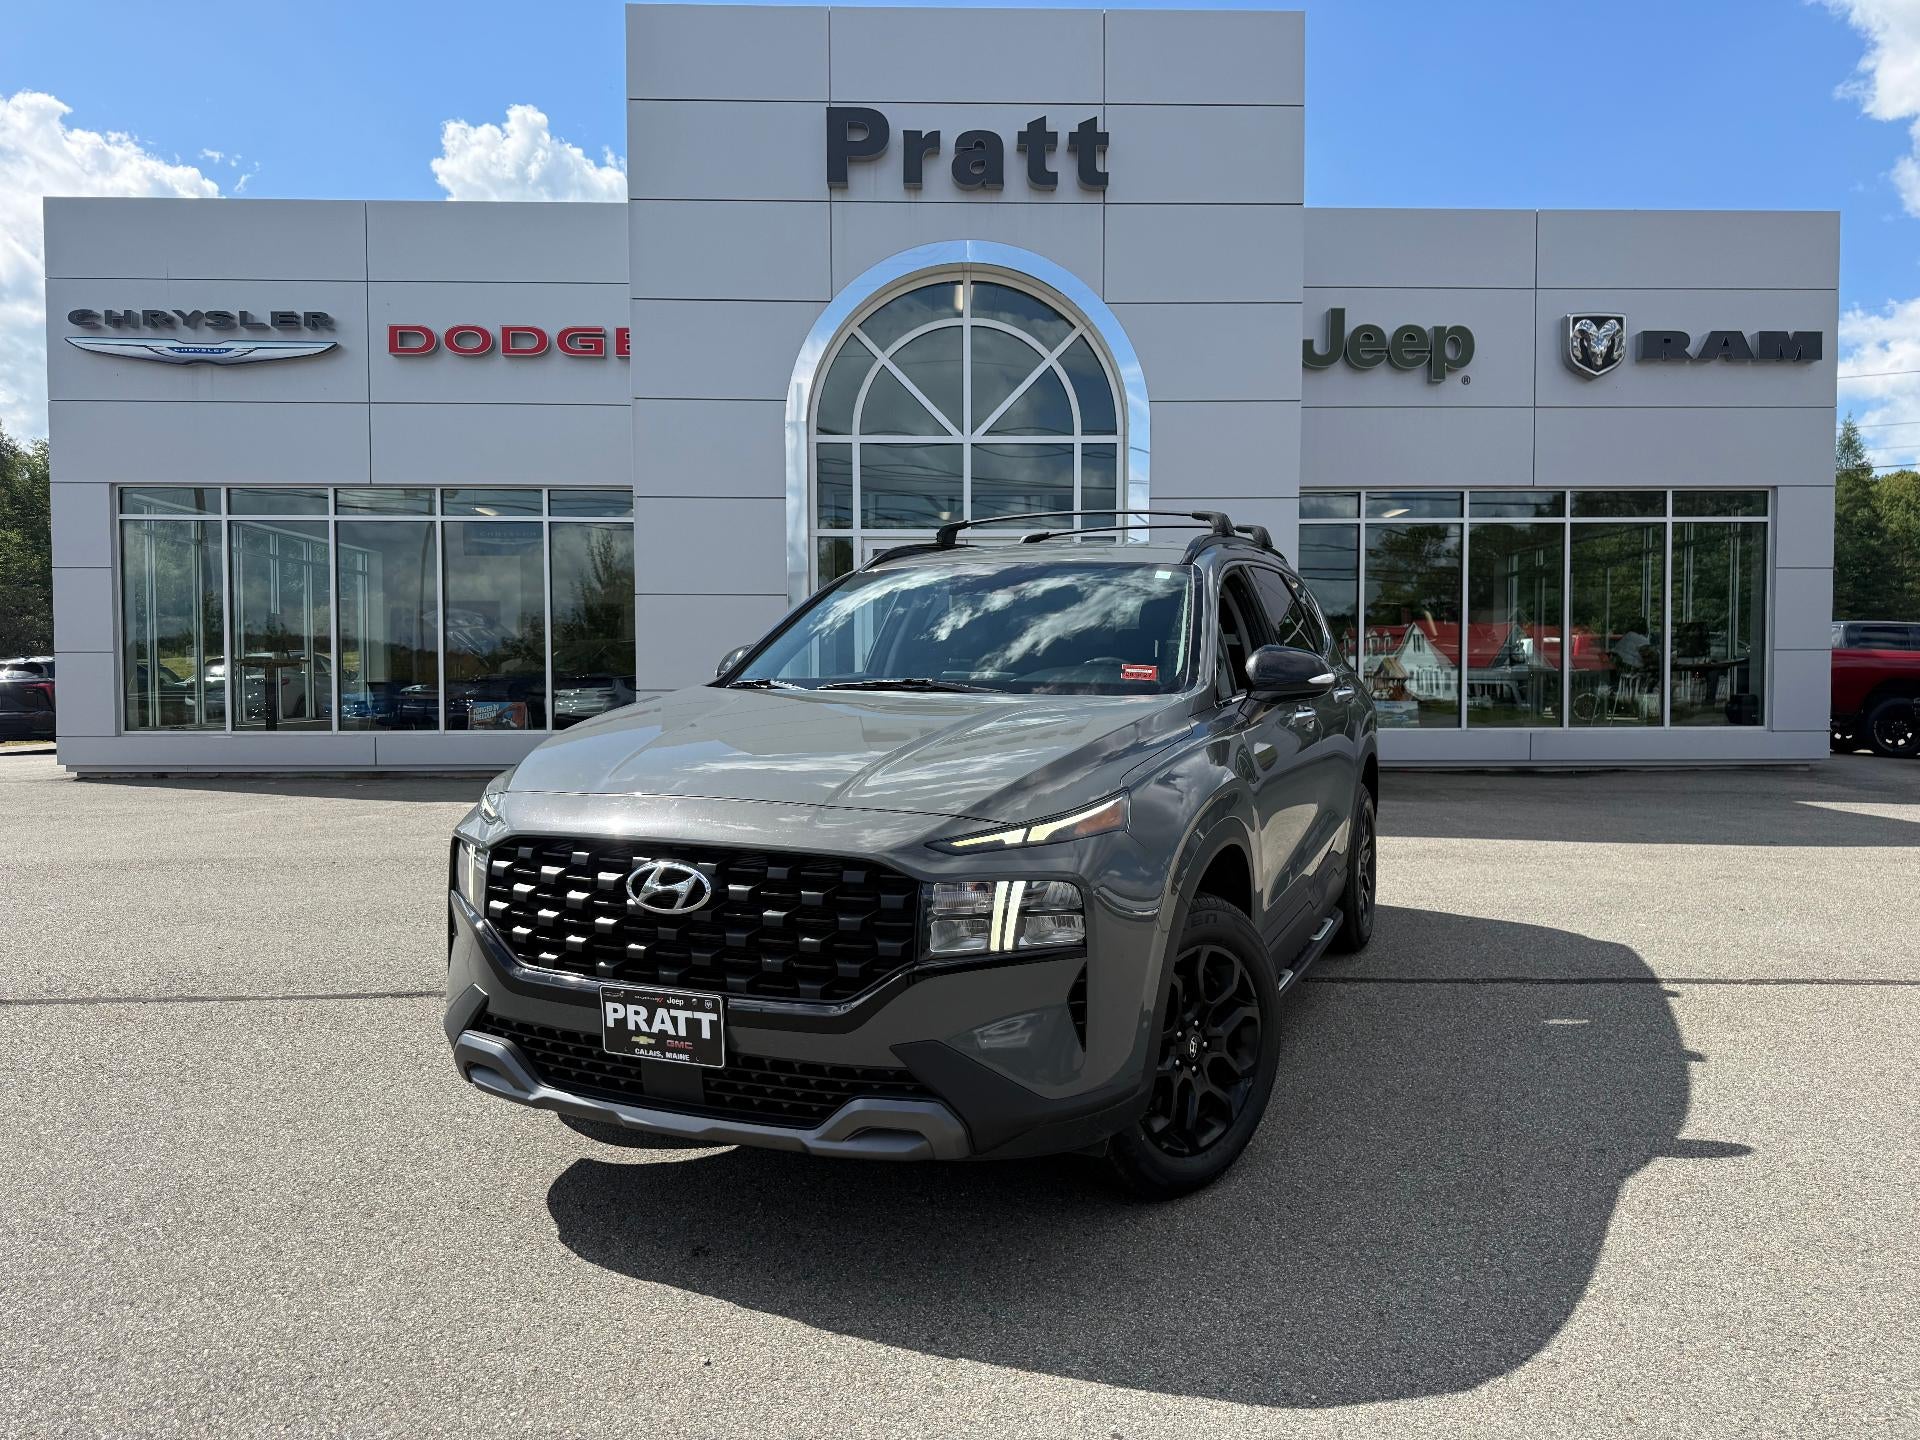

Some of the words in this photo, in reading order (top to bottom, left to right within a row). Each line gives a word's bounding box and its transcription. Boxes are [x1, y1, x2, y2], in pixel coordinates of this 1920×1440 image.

[826, 106, 1109, 190] Pratt
[67, 309, 336, 330] CHRYSLER
[1302, 307, 1476, 384] Jeep
[1635, 329, 1823, 363] RAM
[605, 1001, 718, 1040] PRATT
[665, 1052, 690, 1061] MAINE
[666, 1040, 693, 1050] GMC
